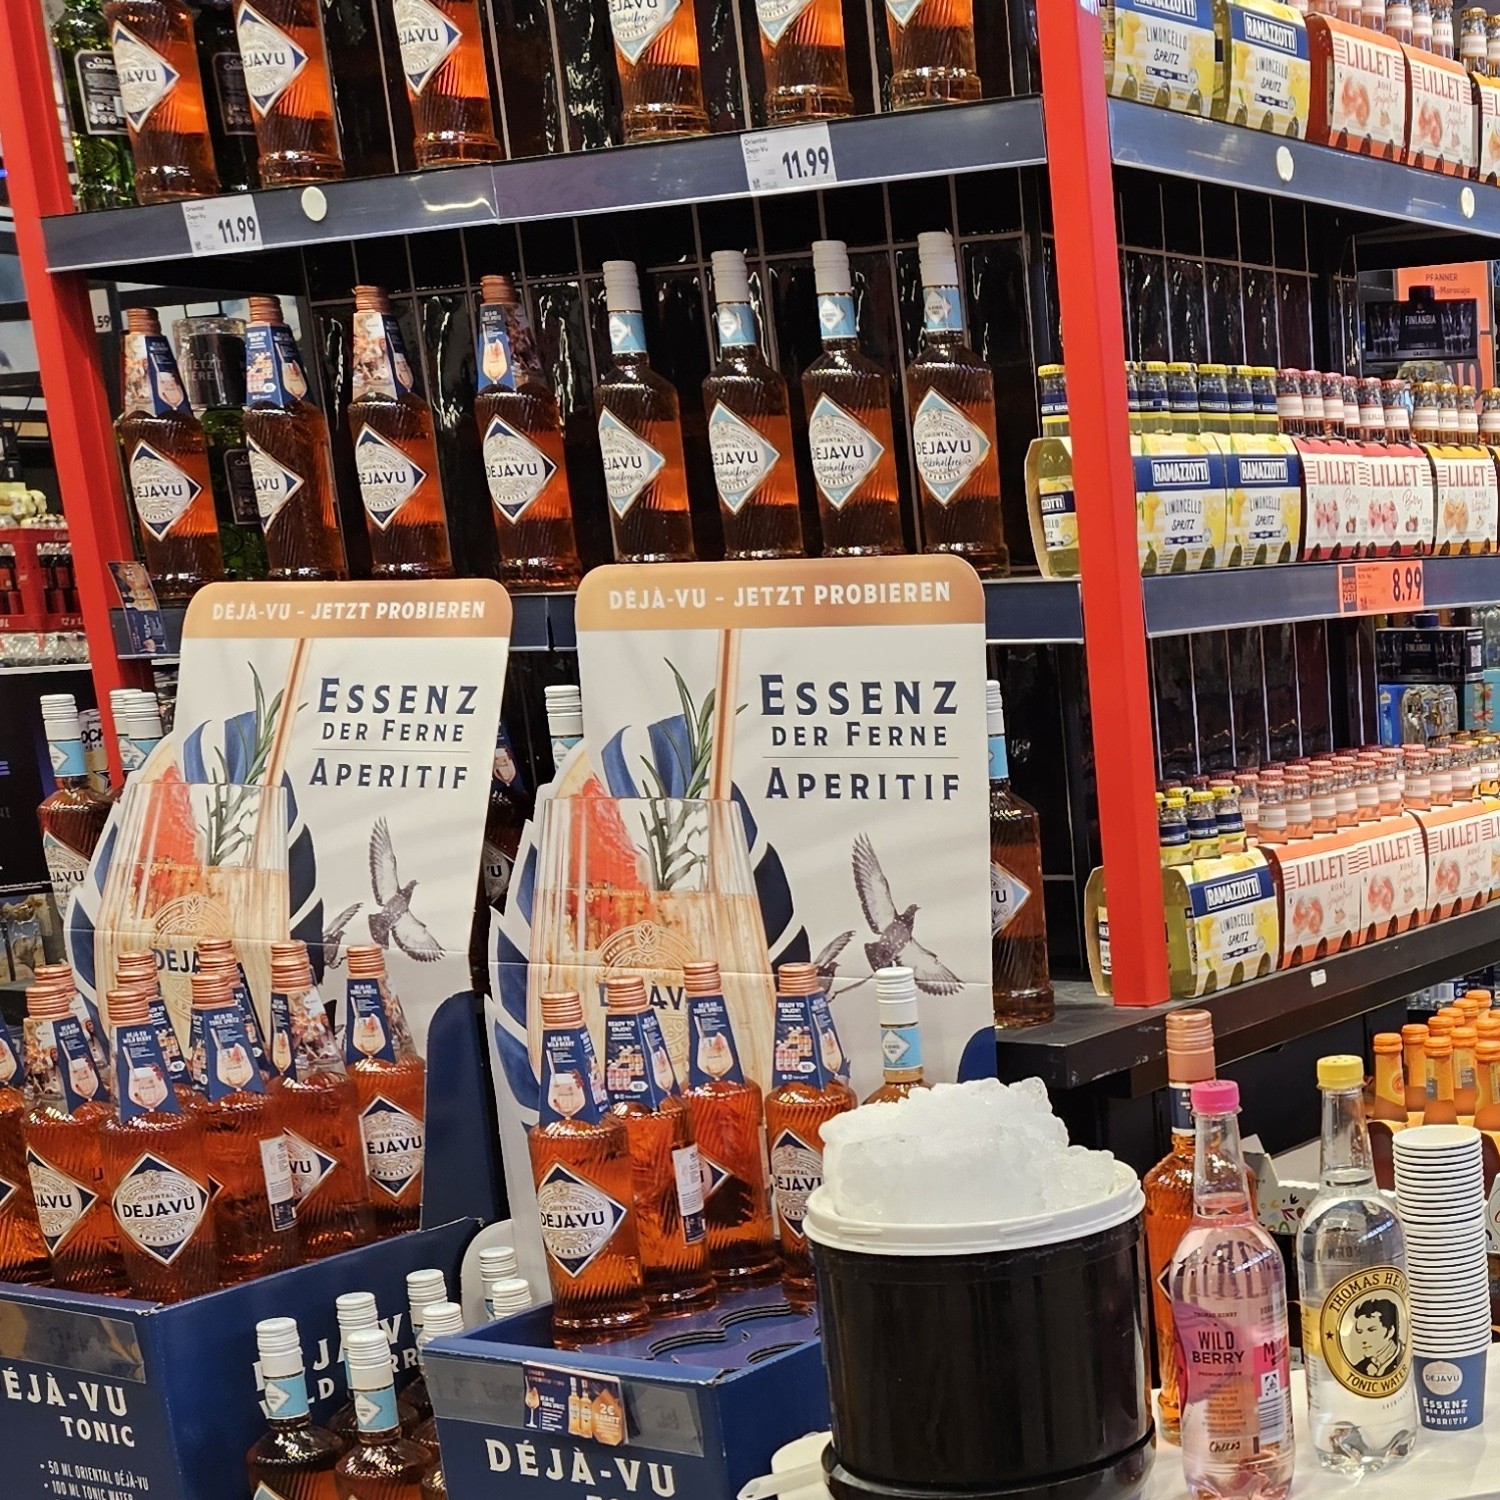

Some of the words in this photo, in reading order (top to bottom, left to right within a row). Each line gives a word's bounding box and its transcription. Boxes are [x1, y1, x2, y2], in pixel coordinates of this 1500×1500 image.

[1246, 17, 1296, 50] RAMAZZOTTI
[1345, 39, 1393, 79] LILLET
[1421, 66, 1462, 103] LILLET
[781, 146, 829, 180] 11.99
[217, 215, 257, 244] 11.99
[1425, 272, 1458, 282] PFANNER
[1154, 461, 1209, 482] RAMAZZOTTI
[1241, 460, 1287, 481] RAMAZZOTTI
[1316, 460, 1357, 486] LILLET
[1371, 464, 1419, 487] LILLET
[1447, 465, 1487, 487] LILLET
[608, 586, 707, 611] DÉJÀ-VU
[733, 586, 806, 609] JETZT
[814, 581, 951, 606] PROBIEREN
[1392, 566, 1423, 603] 8.99
[211, 602, 292, 622] DÉJÀ-VU
[311, 601, 370, 621] JETZT
[376, 600, 485, 621] PROBIEREN
[317, 677, 478, 715] ESSENZ
[760, 674, 958, 716] ESSENZ
[322, 721, 369, 741] DER
[380, 719, 465, 743] FERNE
[771, 725, 828, 747] DER
[846, 721, 948, 747] FERNE
[309, 757, 470, 790] APERITIF
[765, 766, 960, 801] APERITIF
[1368, 834, 1412, 868] LILLET
[1439, 821, 1480, 852] LILLET
[1295, 853, 1346, 889] LILLET
[1205, 876, 1261, 909] RAMAZZOTTI
[1329, 1275, 1380, 1314] THOMAS
[1197, 1329, 1234, 1350] WILD
[1191, 1350, 1245, 1365] BERRY
[2, 1366, 128, 1417] ÉJÀ-VU
[1345, 1370, 1378, 1393] TONIC
[1380, 1363, 1410, 1392] WATER
[60, 1415, 136, 1448] TONIC
[48, 1460, 60, 1476] 50
[61, 1463, 74, 1479] ML
[75, 1464, 114, 1486] ORIENTAL
[114, 1469, 149, 1491] DÉJÀ-VU
[484, 1438, 676, 1499] DÉJÀ-VU
[52, 1480, 67, 1496] 100
[68, 1483, 81, 1498] ML
